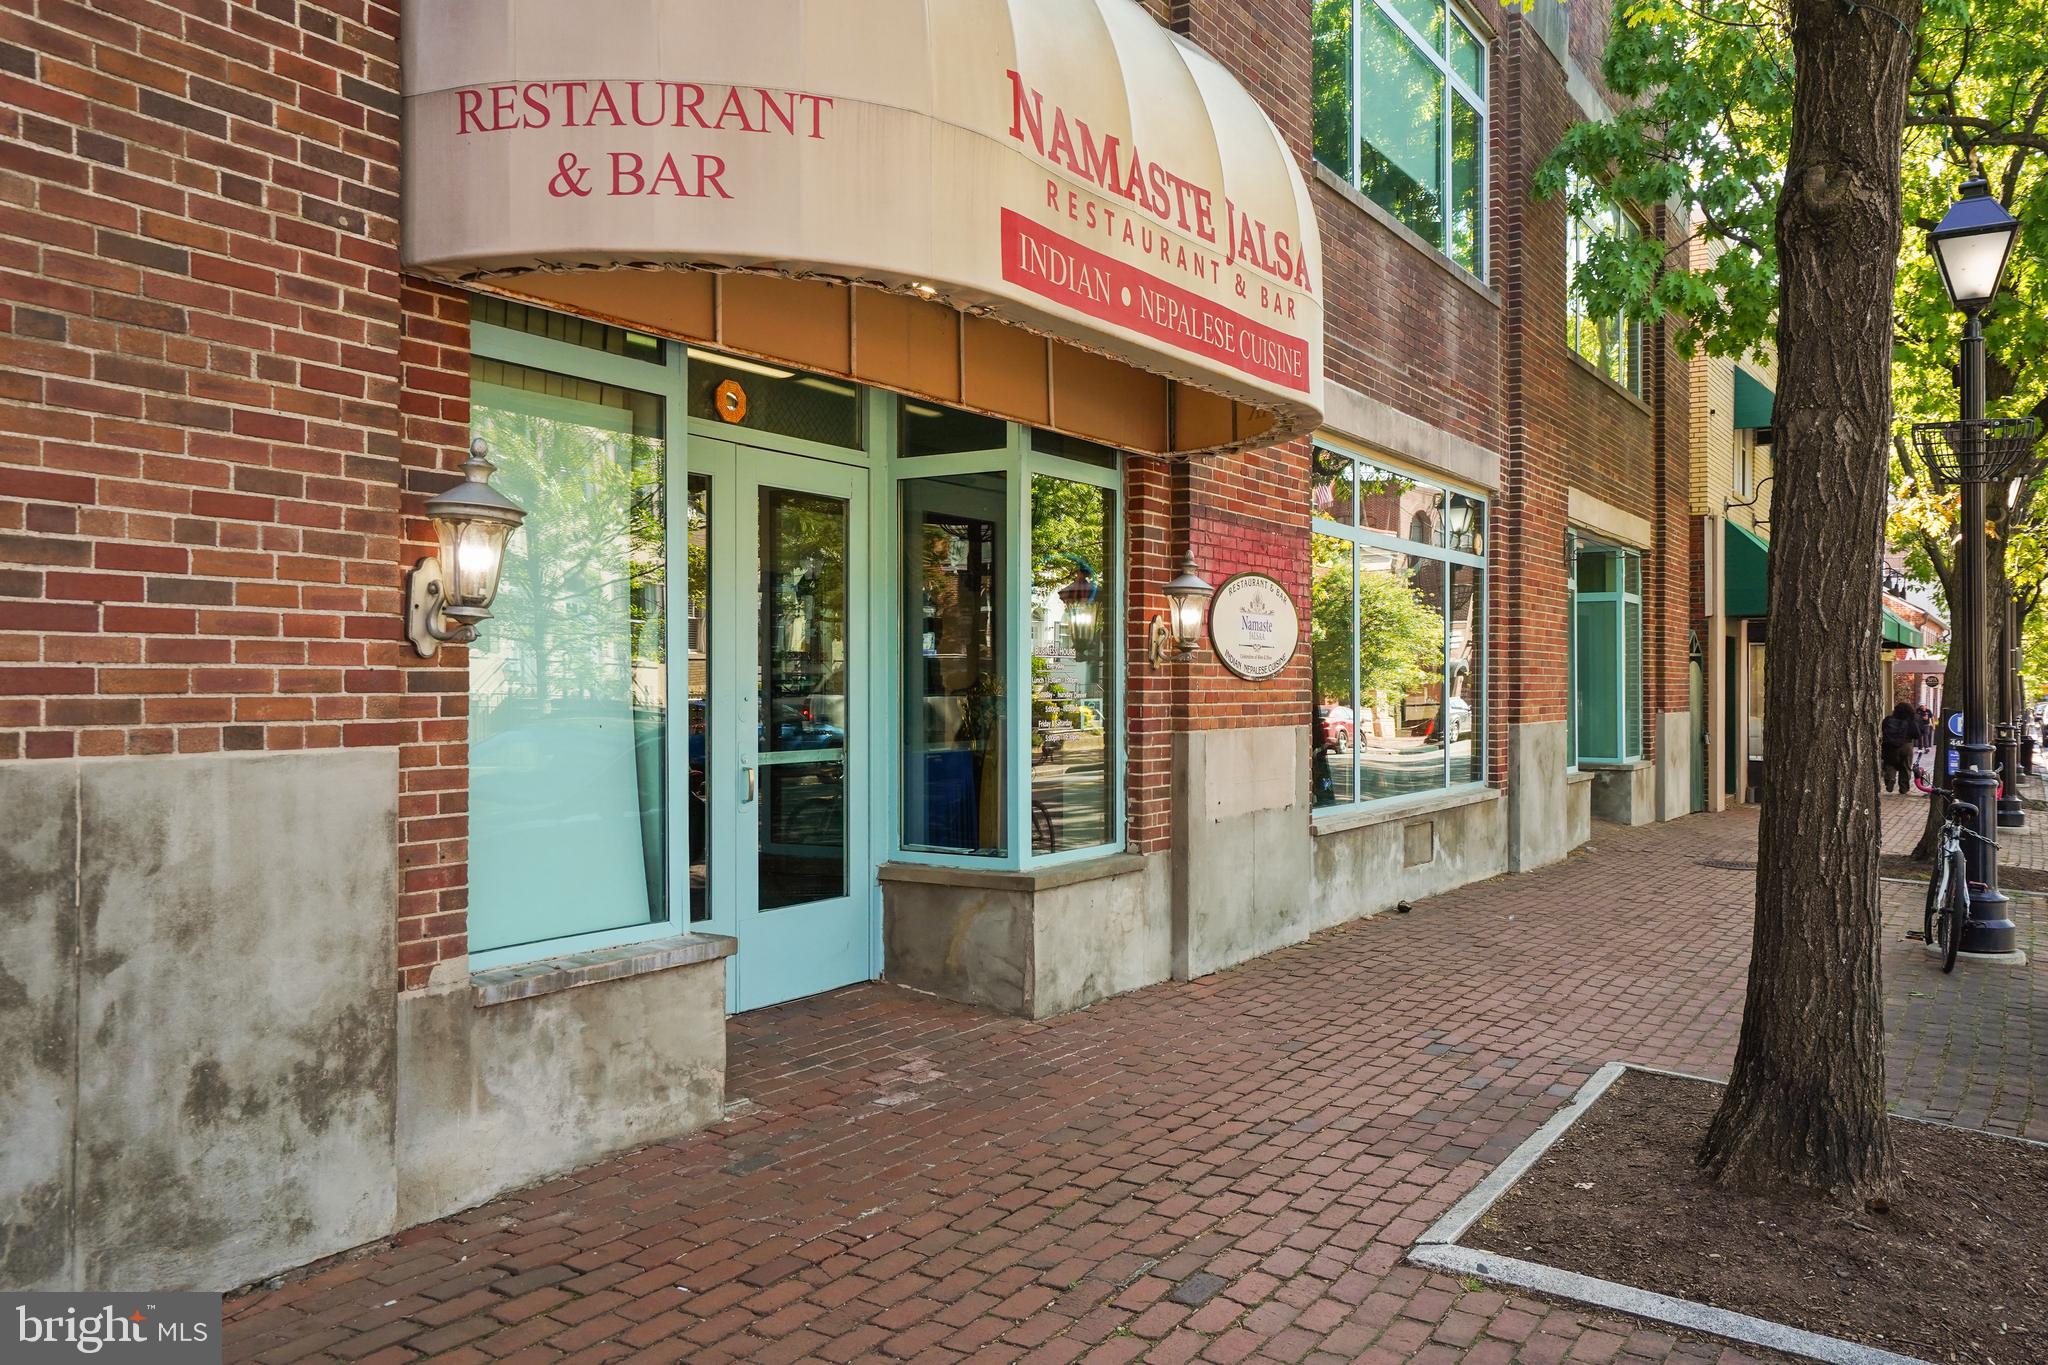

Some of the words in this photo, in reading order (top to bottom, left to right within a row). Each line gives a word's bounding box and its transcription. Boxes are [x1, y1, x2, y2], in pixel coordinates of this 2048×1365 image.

[454, 81, 834, 139] RESTAURANT
[548, 152, 593, 198] &
[606, 152, 735, 199] BAR
[1006, 69, 1216, 244] NAMASTE
[1225, 197, 1312, 293] JALSA
[1047, 179, 1219, 284] RESTAURANT
[1235, 273, 1247, 299] &
[1261, 286, 1296, 320] BAR
[1019, 232, 1111, 305] INDIAN
[1139, 285, 1236, 353] NEPALESE
[1239, 330, 1303, 378] CUISINE
[1228, 578, 1268, 597] RESTAURANT
[1269, 583, 1275, 592] &
[1276, 588, 1288, 605] BAR
[1241, 615, 1273, 633] Namaste
[1035, 647, 1058, 656] BUSINESS
[1059, 647, 1076, 656] HOURS
[1224, 648, 1242, 670] INDIAN
[1243, 663, 1268, 674] NEPALESE
[1267, 652, 1287, 672] CUISINE
